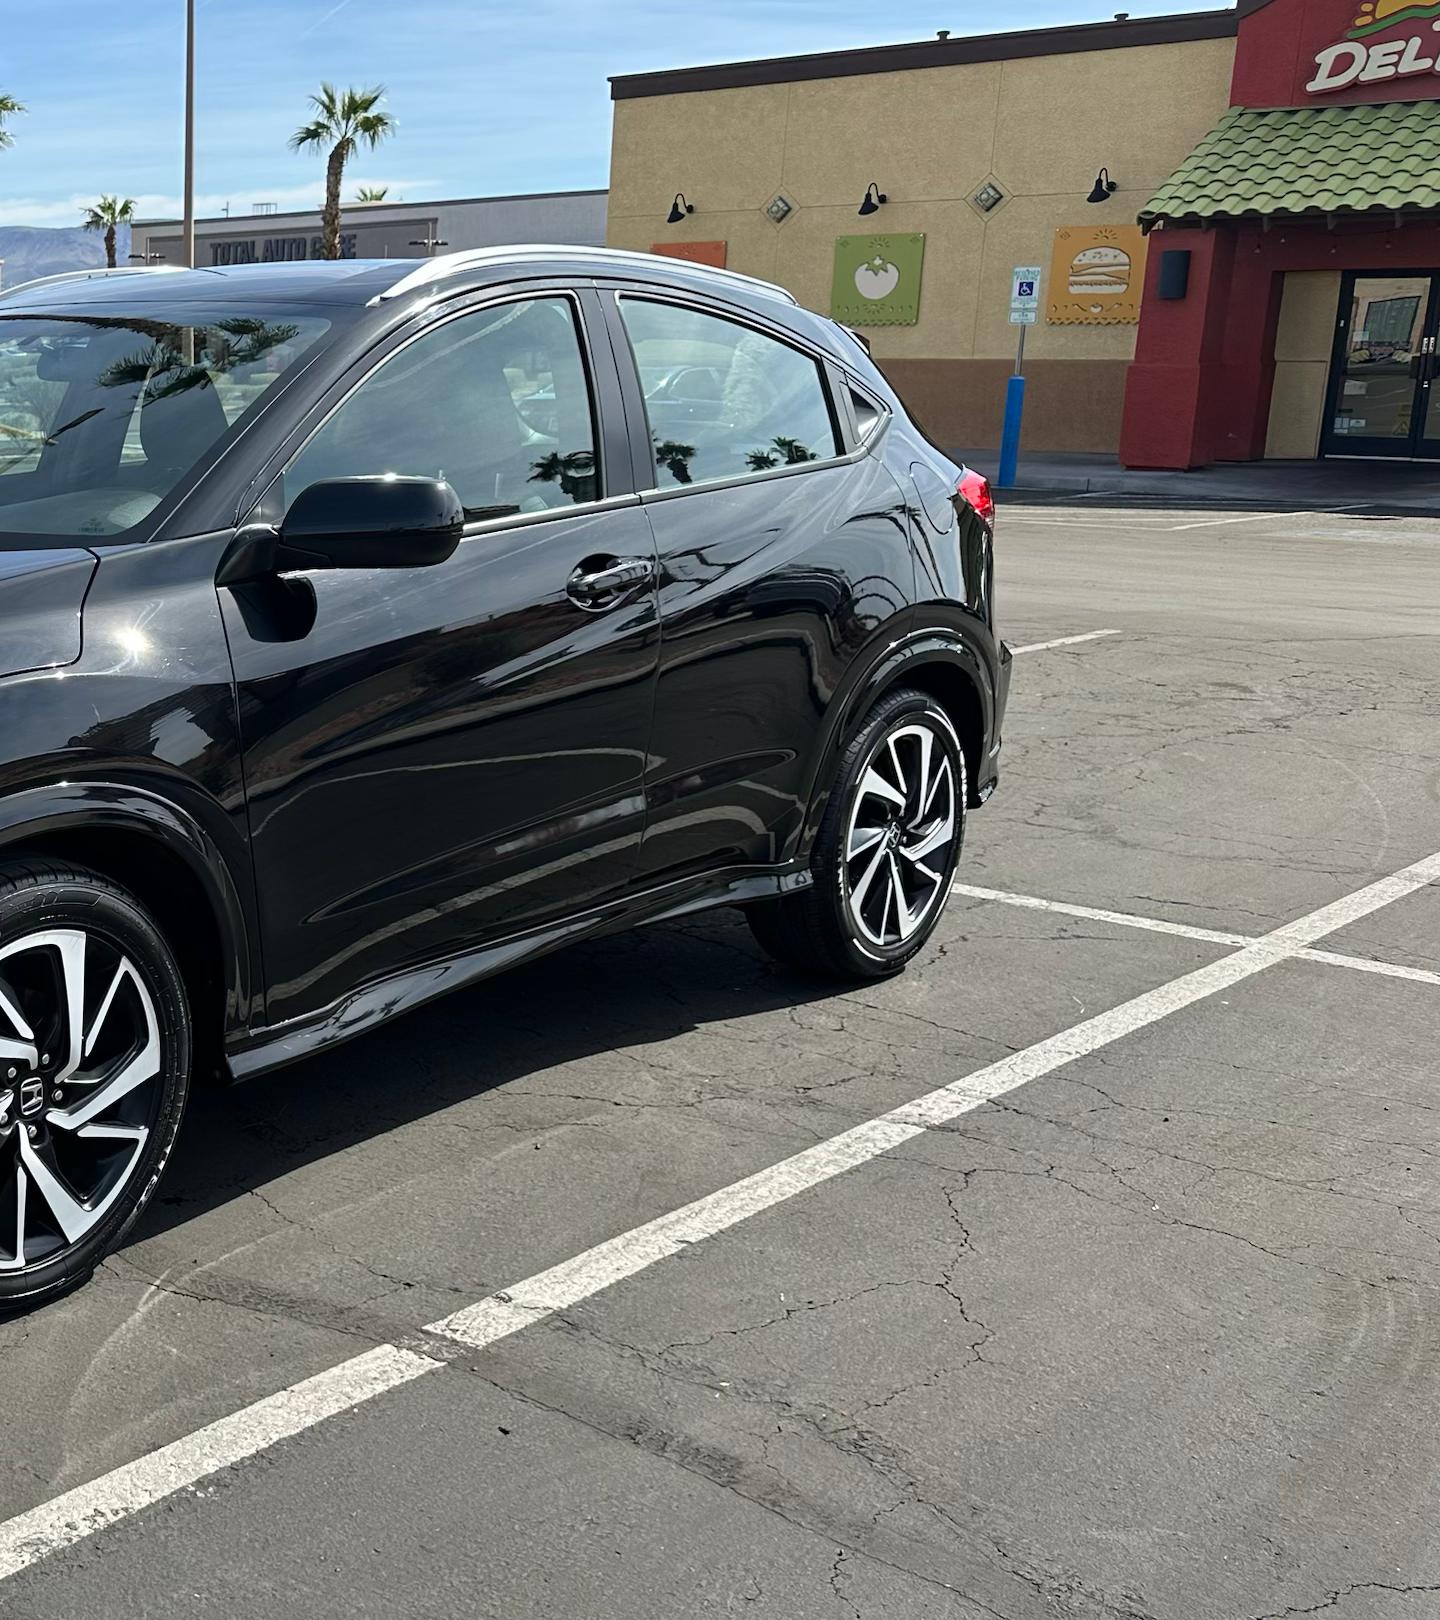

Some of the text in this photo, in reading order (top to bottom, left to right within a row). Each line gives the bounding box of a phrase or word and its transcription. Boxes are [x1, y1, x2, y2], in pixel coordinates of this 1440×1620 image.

[1306, 36, 1433, 92] DEL
[210, 234, 357, 266] TOTAL AUTO CRE
